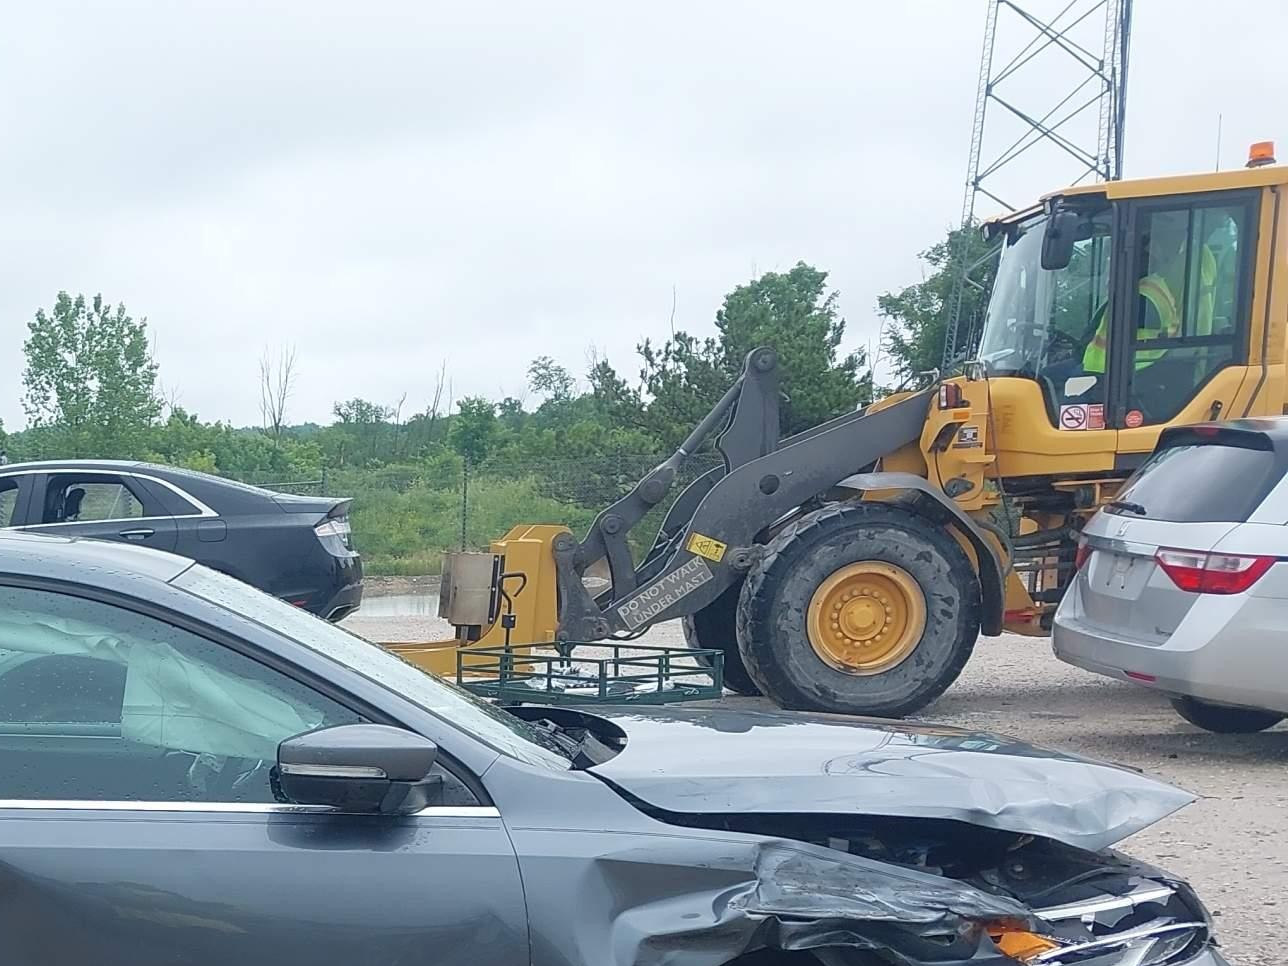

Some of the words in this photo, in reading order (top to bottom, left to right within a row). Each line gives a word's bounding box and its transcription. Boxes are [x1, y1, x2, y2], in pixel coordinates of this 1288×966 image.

[621, 601, 639, 616] DO
[640, 582, 666, 603] NOT
[667, 558, 703, 584] WALK
[633, 593, 673, 624] UNDER
[674, 571, 705, 597] MAST
